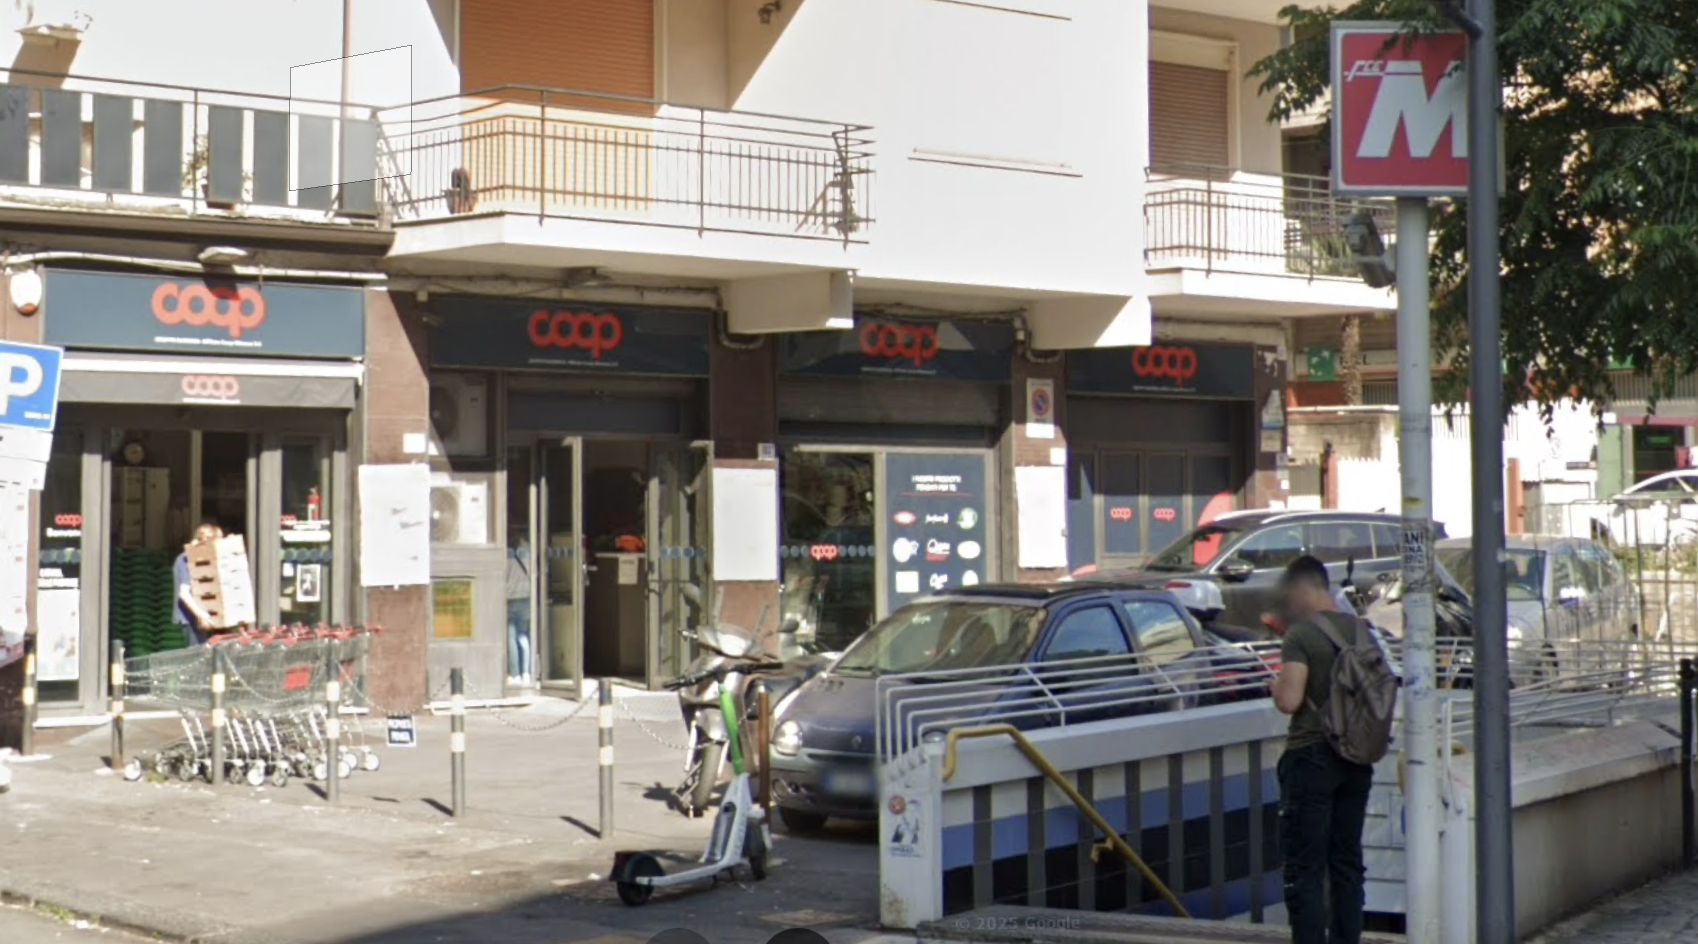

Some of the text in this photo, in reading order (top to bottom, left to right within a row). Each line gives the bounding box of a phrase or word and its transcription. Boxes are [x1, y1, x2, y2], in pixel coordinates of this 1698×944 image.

[1356, 60, 1468, 158] M
[151, 282, 265, 338] coop
[527, 309, 623, 358] coop
[859, 322, 939, 368] coop
[1131, 345, 1198, 387] coop
[0, 352, 44, 416] P
[181, 374, 239, 399] coop
